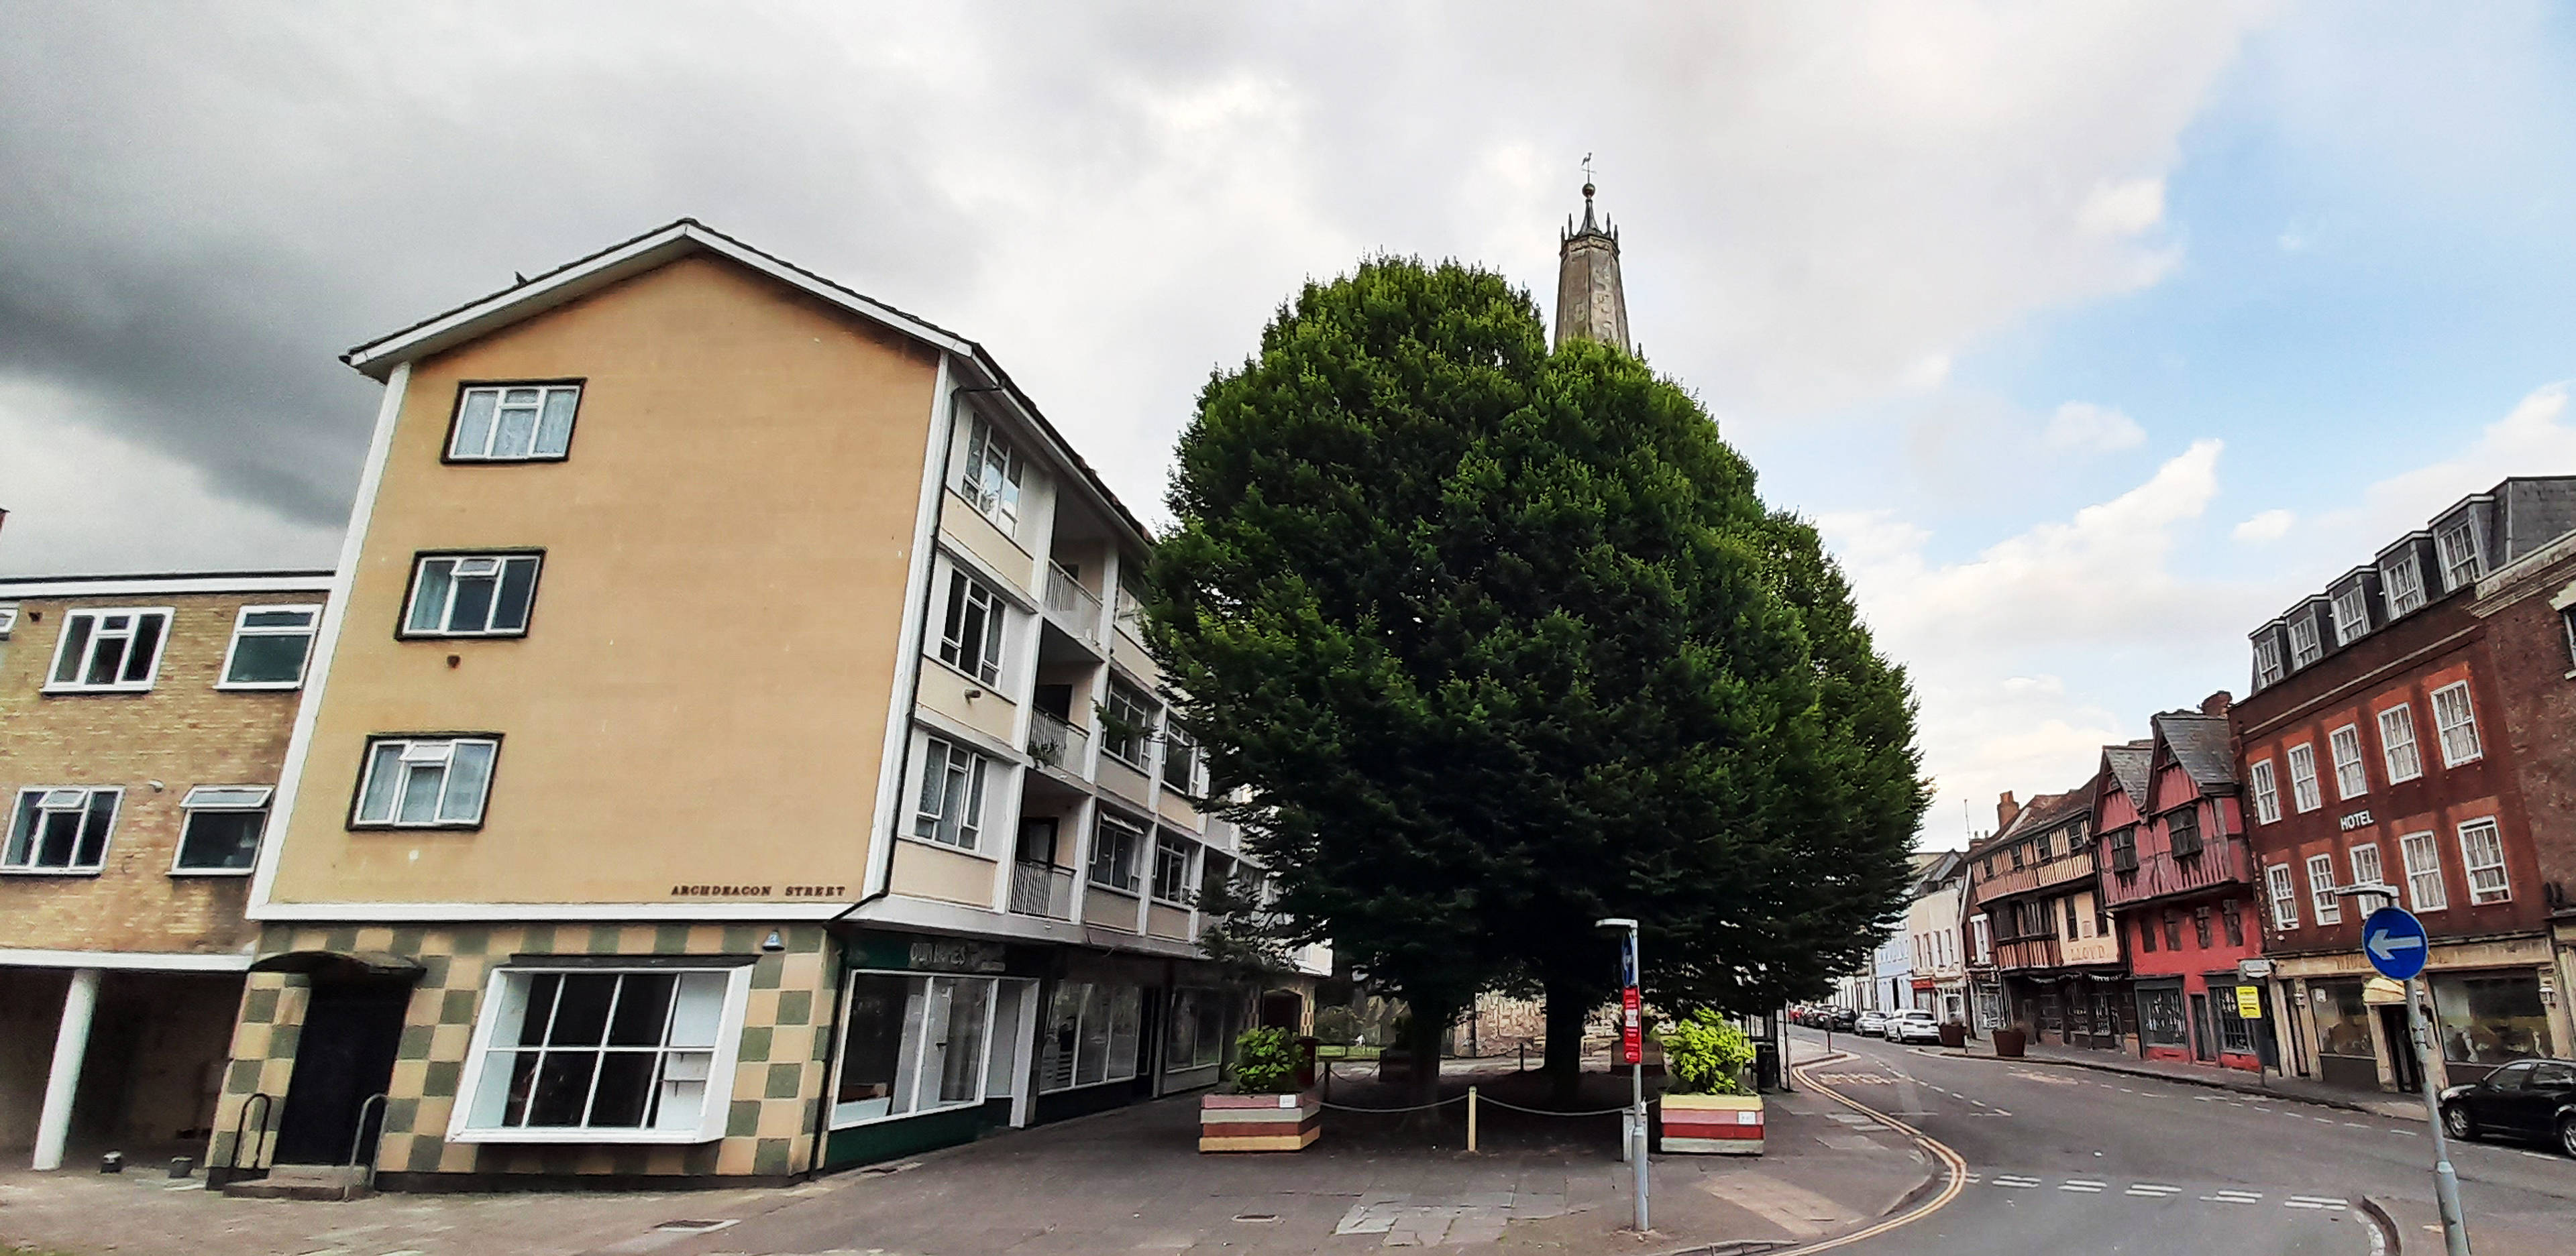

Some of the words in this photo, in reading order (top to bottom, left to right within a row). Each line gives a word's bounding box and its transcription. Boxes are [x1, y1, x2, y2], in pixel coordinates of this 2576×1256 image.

[2340, 810, 2374, 831] HOTEL
[671, 885, 772, 897] ARCHDEACON
[785, 886, 846, 897] STREET
